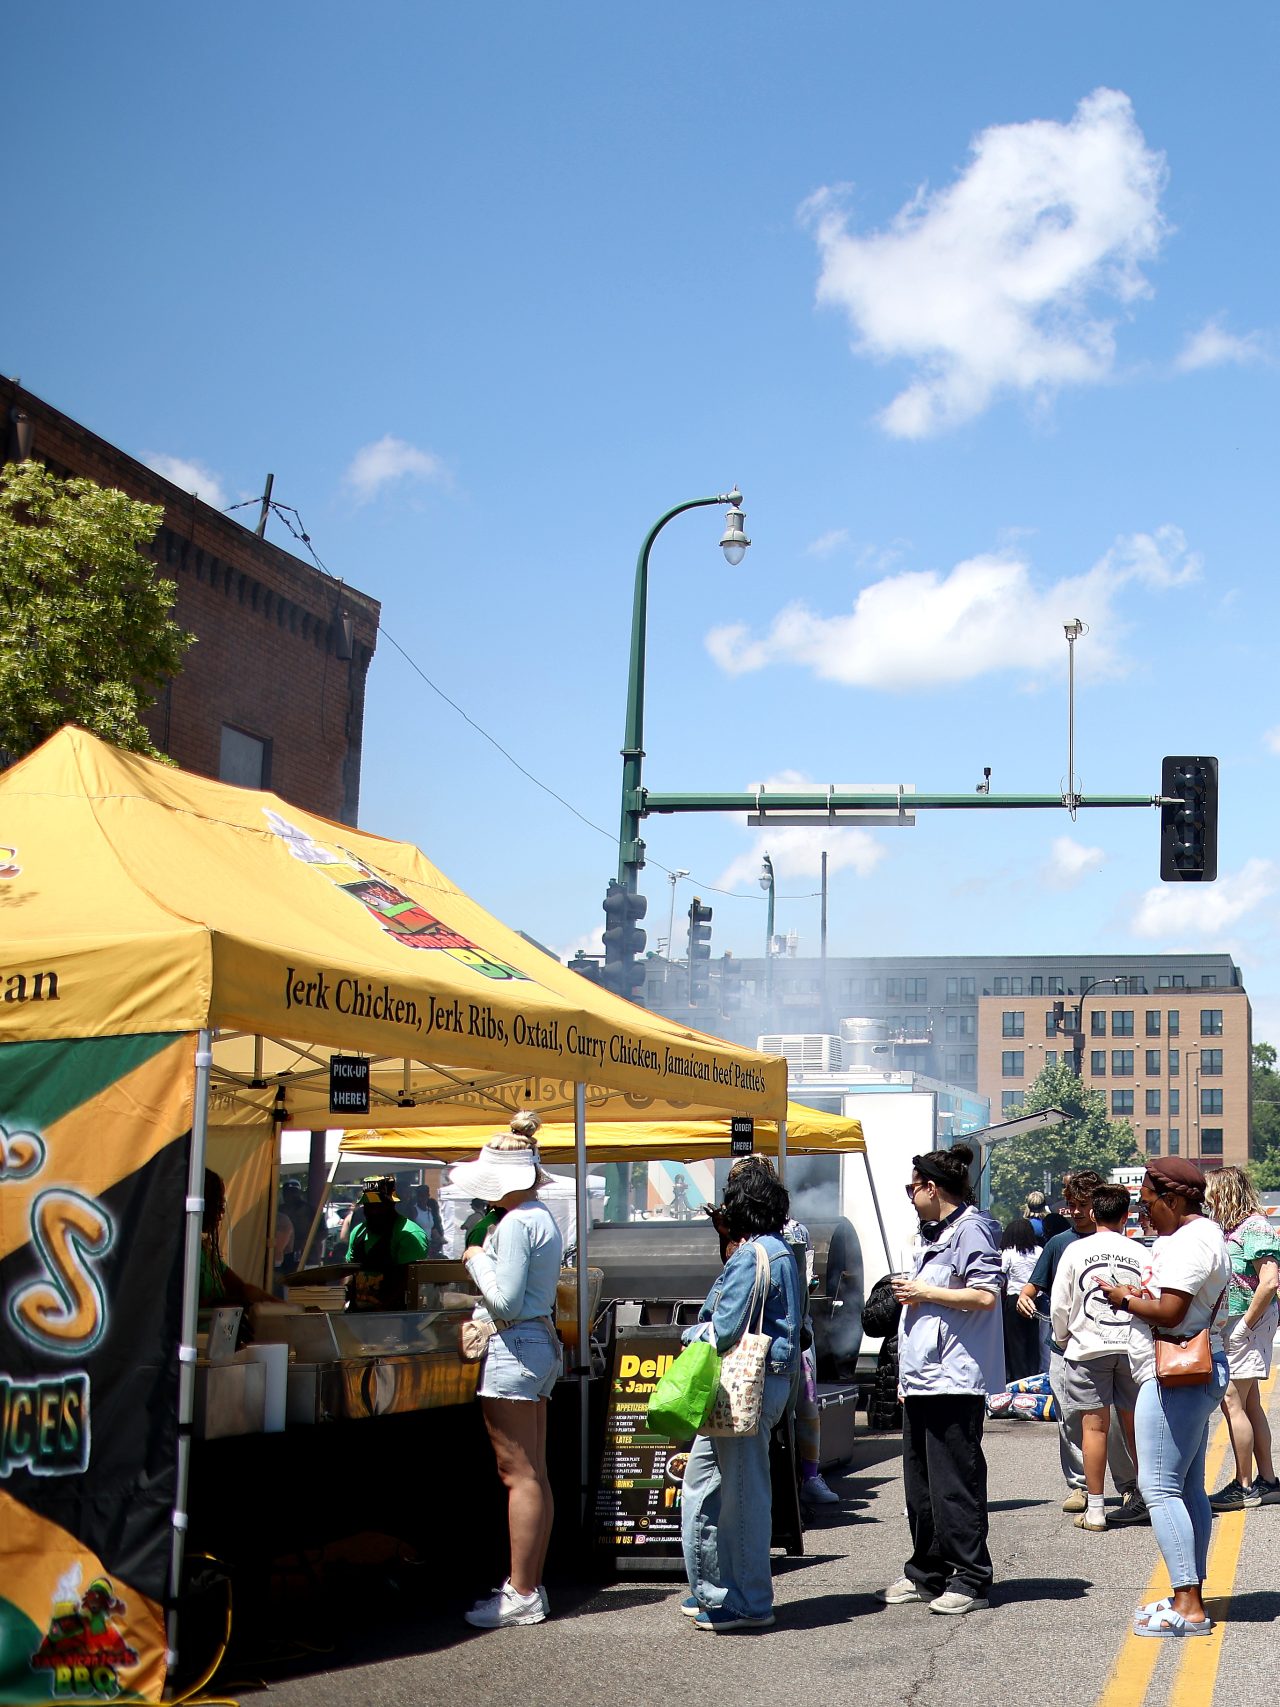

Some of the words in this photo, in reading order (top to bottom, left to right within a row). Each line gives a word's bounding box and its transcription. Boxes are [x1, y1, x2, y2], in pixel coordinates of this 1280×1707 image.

[0, 970, 60, 1002] an
[286, 967, 329, 1010] Jerk
[336, 978, 422, 1032] Chicken,
[426, 996, 464, 1034] Jerk
[468, 1005, 508, 1046] Ribs,
[514, 1014, 562, 1056] Oxtail,
[566, 1026, 607, 1067] Curry
[610, 1034, 660, 1075] Chicken,
[663, 1046, 710, 1080] Jamaican
[712, 1058, 733, 1086] beef
[334, 1064, 367, 1078] PICK-UP
[338, 1092, 362, 1106] HERE
[1084, 1254, 1100, 1266] NO
[1100, 1254, 1140, 1268] SNAKES
[620, 1355, 674, 1379] Dell
[55, 1666, 119, 1698] BBQ
